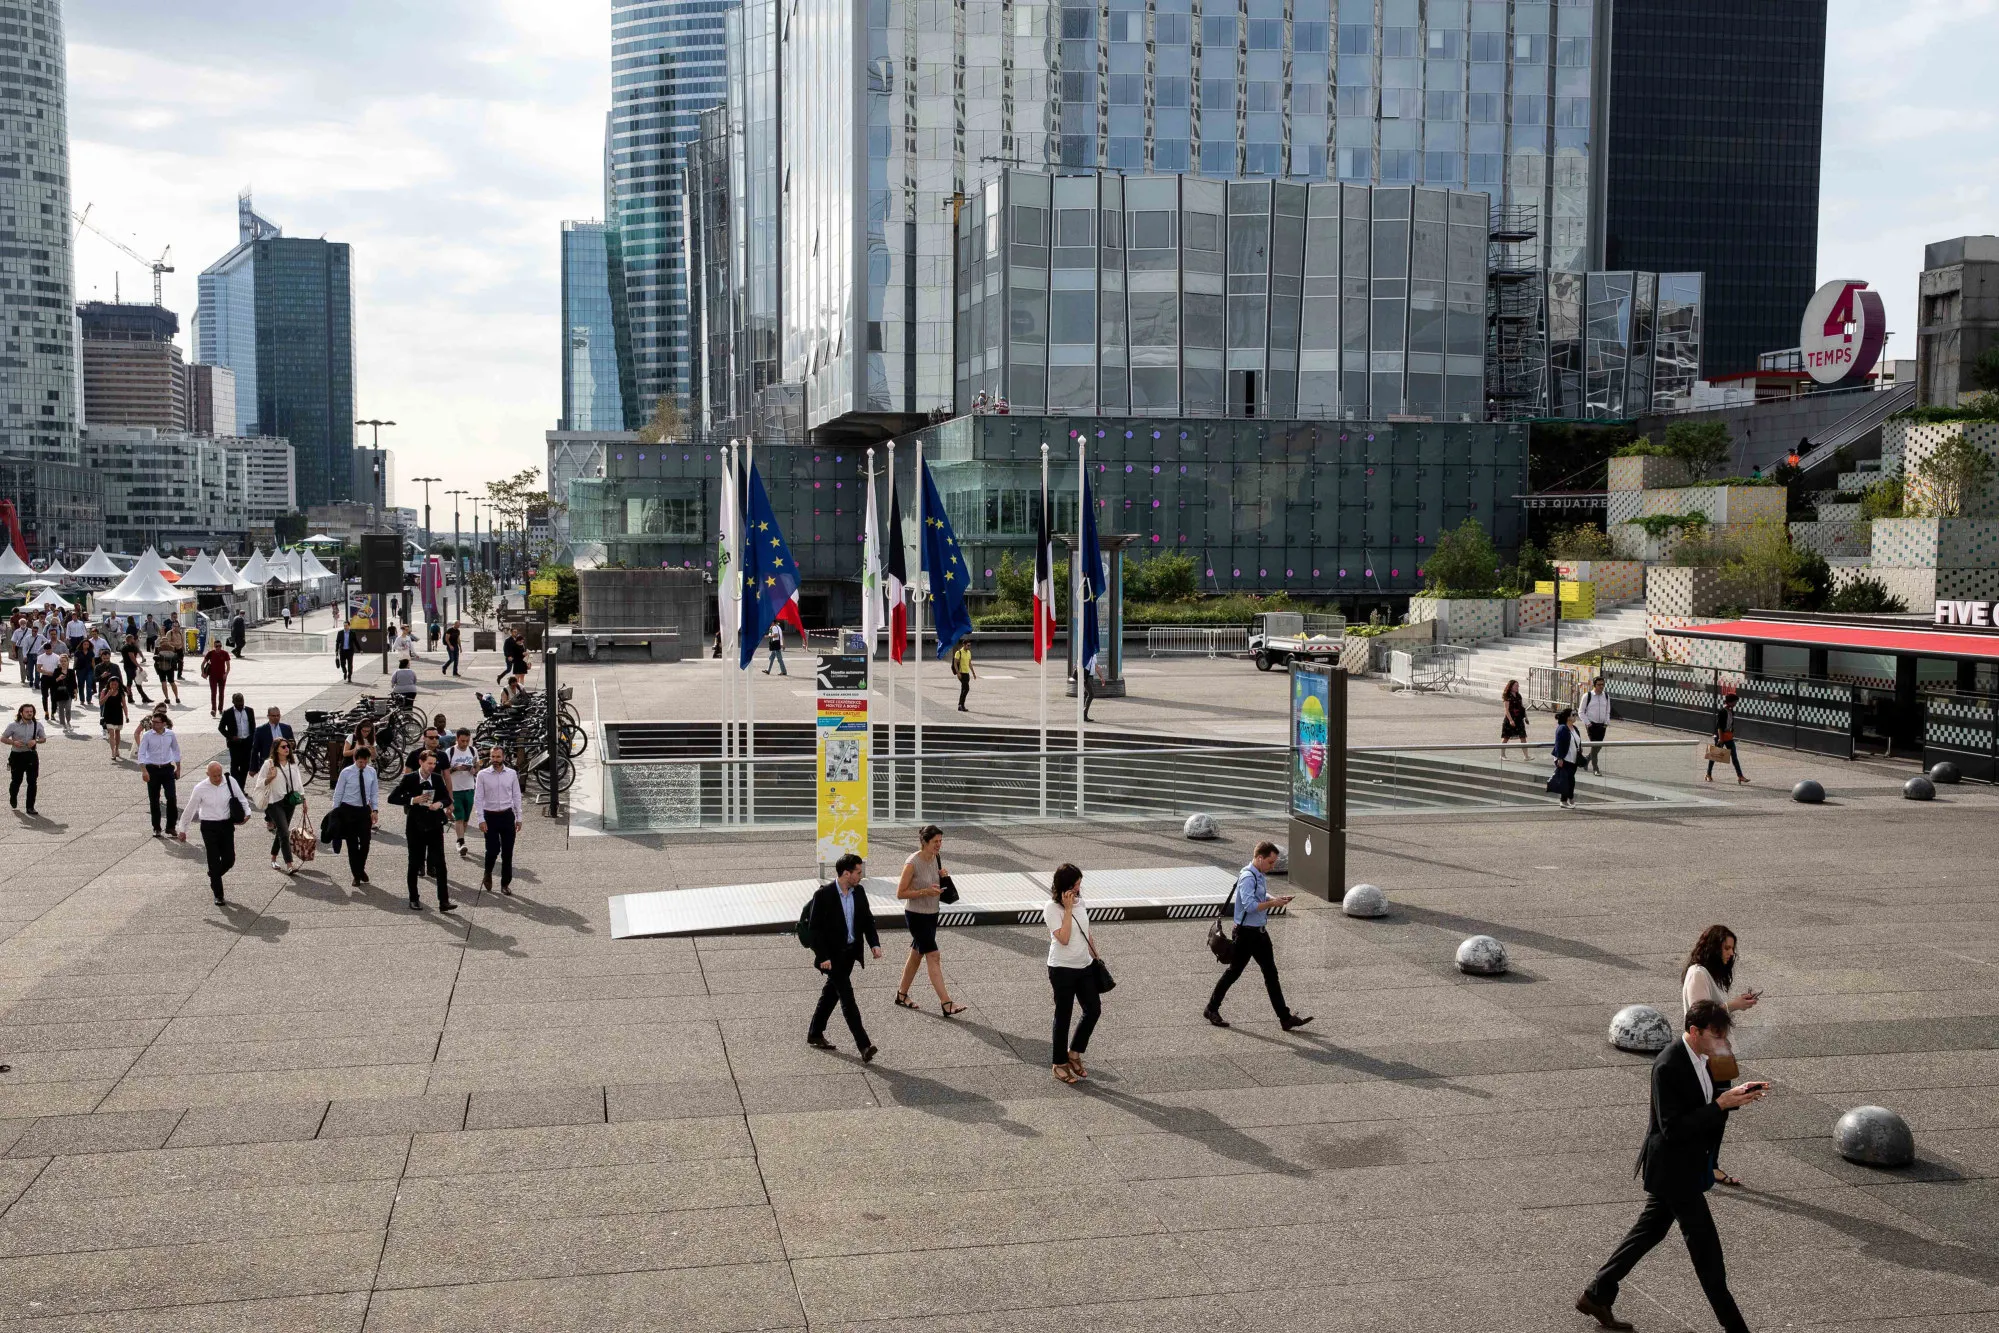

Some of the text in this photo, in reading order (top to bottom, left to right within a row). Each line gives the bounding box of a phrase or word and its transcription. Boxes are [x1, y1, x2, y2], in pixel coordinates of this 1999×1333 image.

[1822, 281, 1869, 343] 4
[1807, 347, 1853, 368] TEMPS
[1523, 499, 1608, 509] LES QUATRE
[1935, 600, 1990, 626] FIVE
